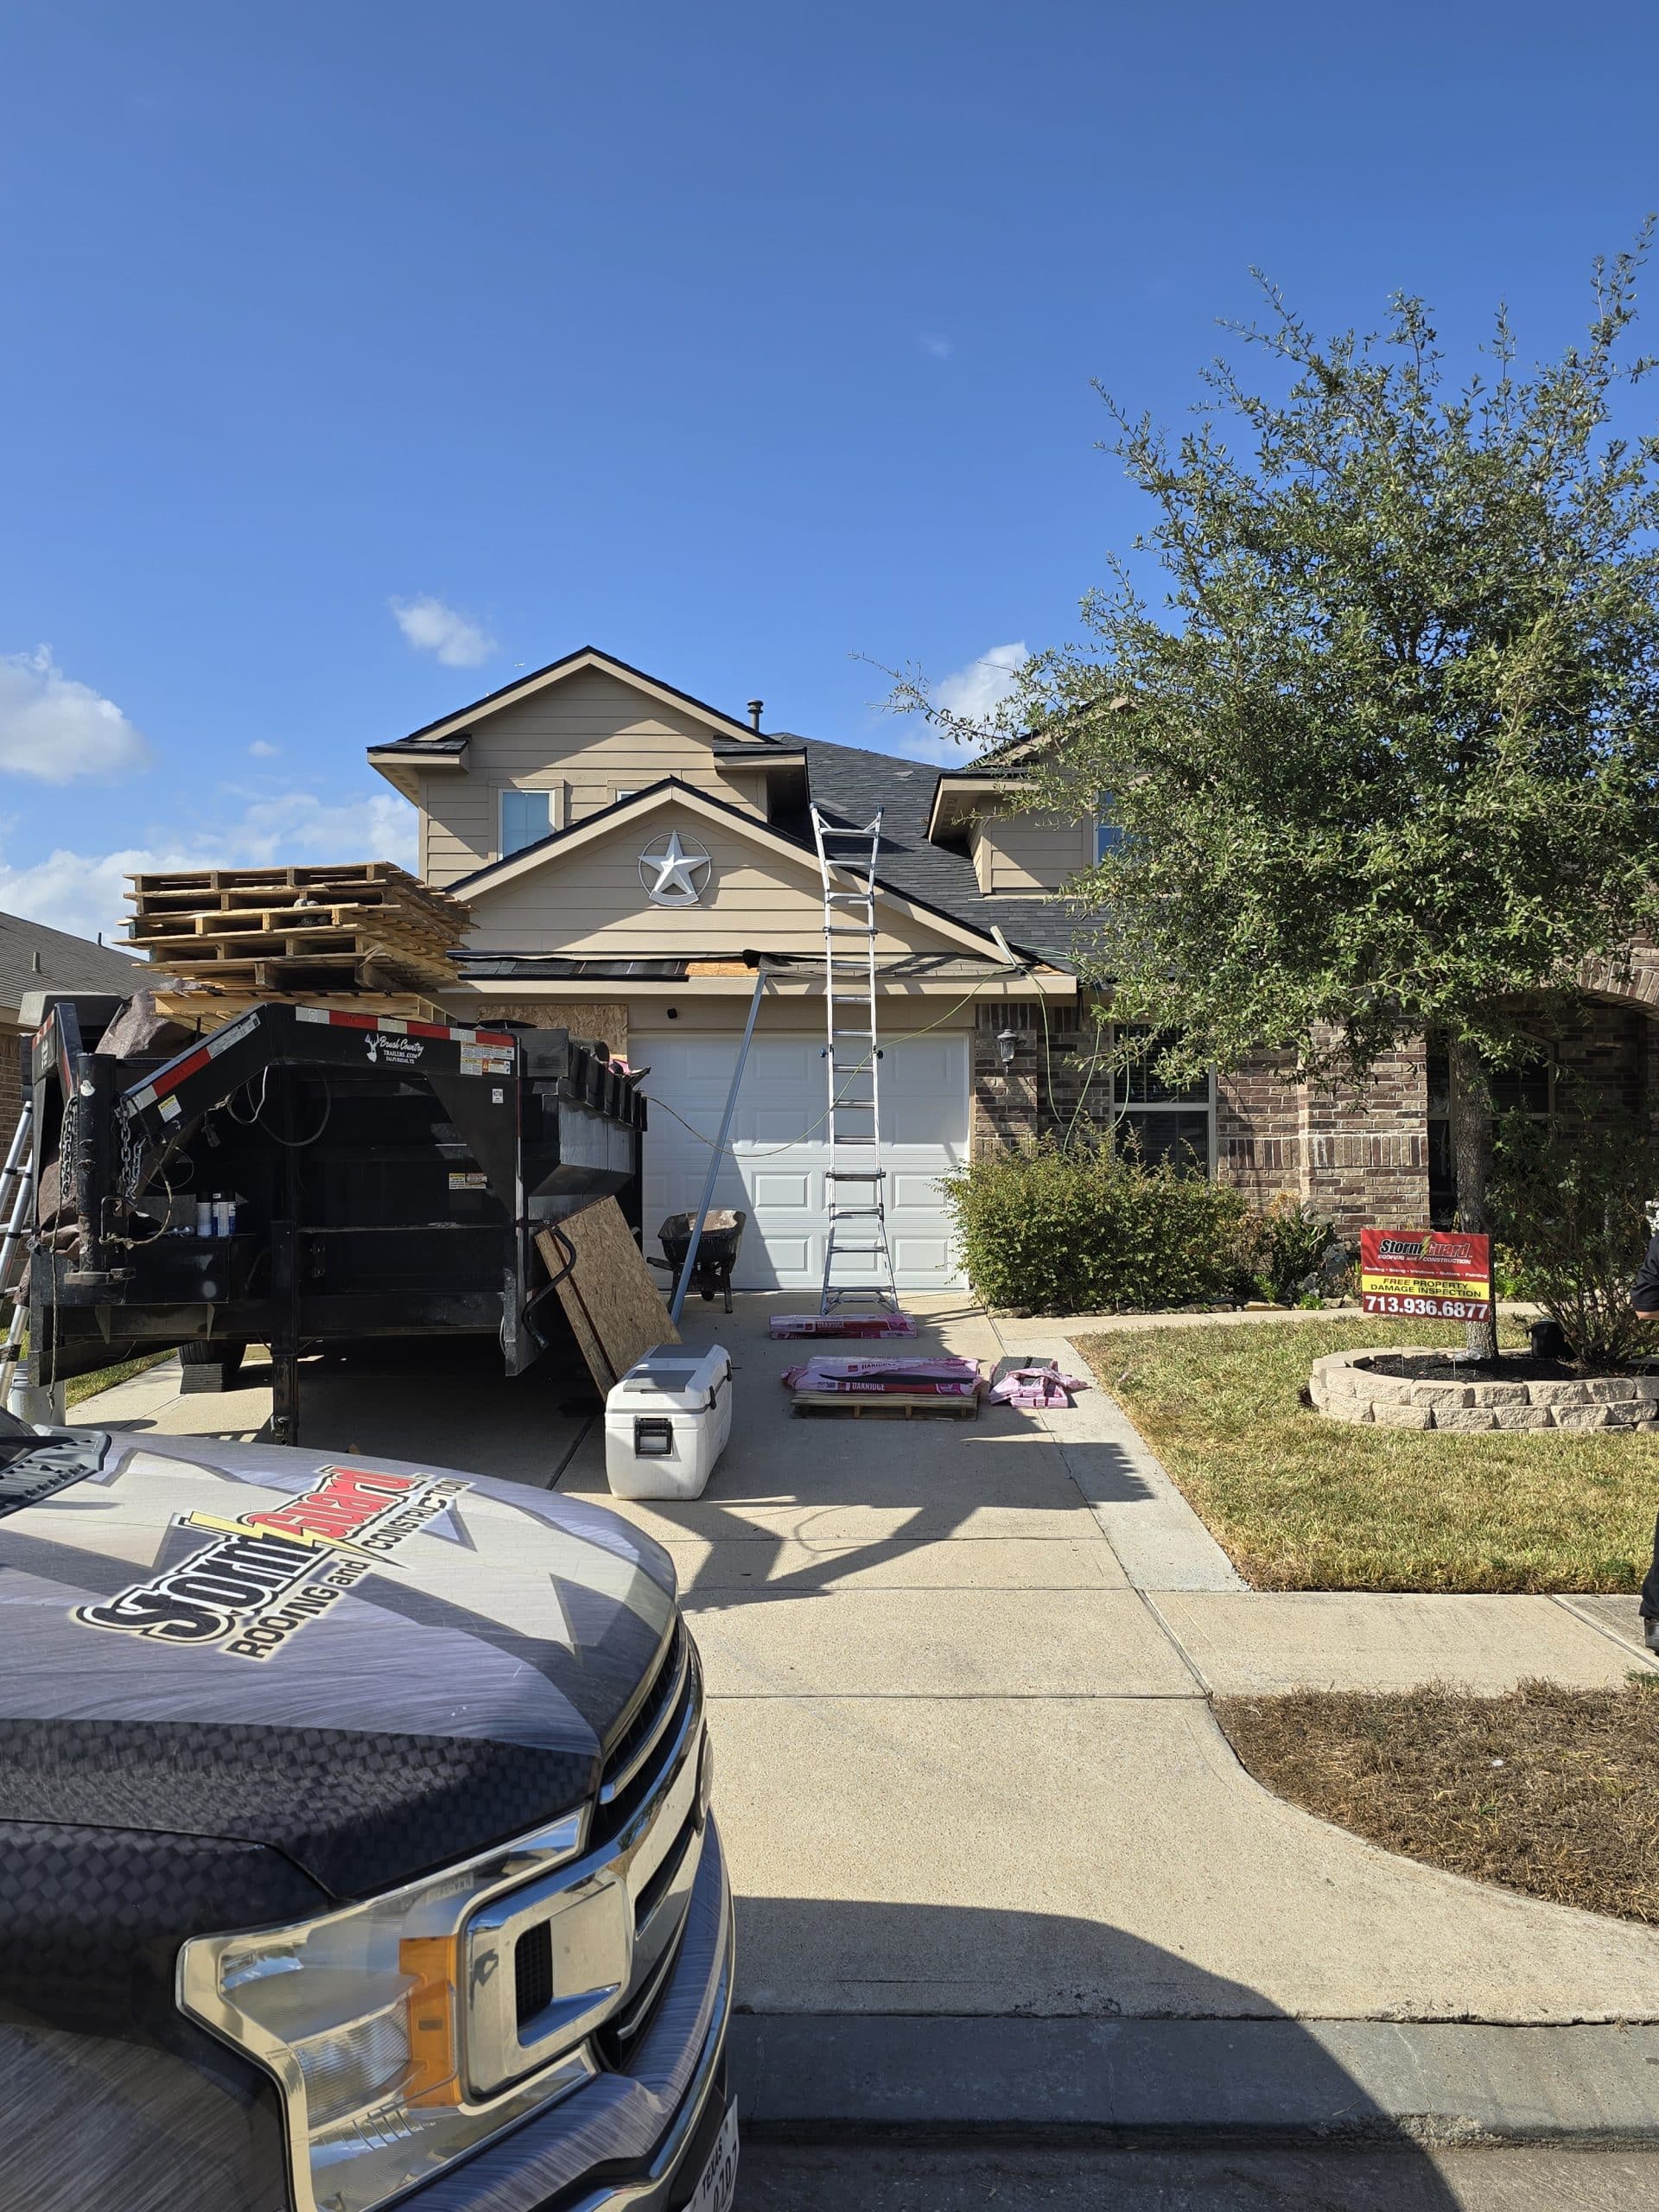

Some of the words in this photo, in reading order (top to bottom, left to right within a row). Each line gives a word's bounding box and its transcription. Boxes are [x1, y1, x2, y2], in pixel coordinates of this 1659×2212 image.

[379, 1036, 400, 1049] Brush
[400, 1038, 424, 1057] Country
[1380, 1239, 1422, 1255] Storm
[1427, 1242, 1471, 1258] Guard
[1422, 1256, 1471, 1265] CONSTRUCTION
[1370, 1284, 1415, 1294] DAMAGE
[1418, 1286, 1482, 1298] INSPECTION
[1413, 1280, 1468, 1290] PROPERTY
[1365, 1295, 1488, 1319] 713.936.6877
[852, 1382, 886, 1391] OAKRIDGE
[243, 1466, 418, 1540] Guard
[327, 1559, 371, 1586] and
[361, 1478, 471, 1551] CONSTRUCTION
[702, 2137, 722, 2200] TEXAS
